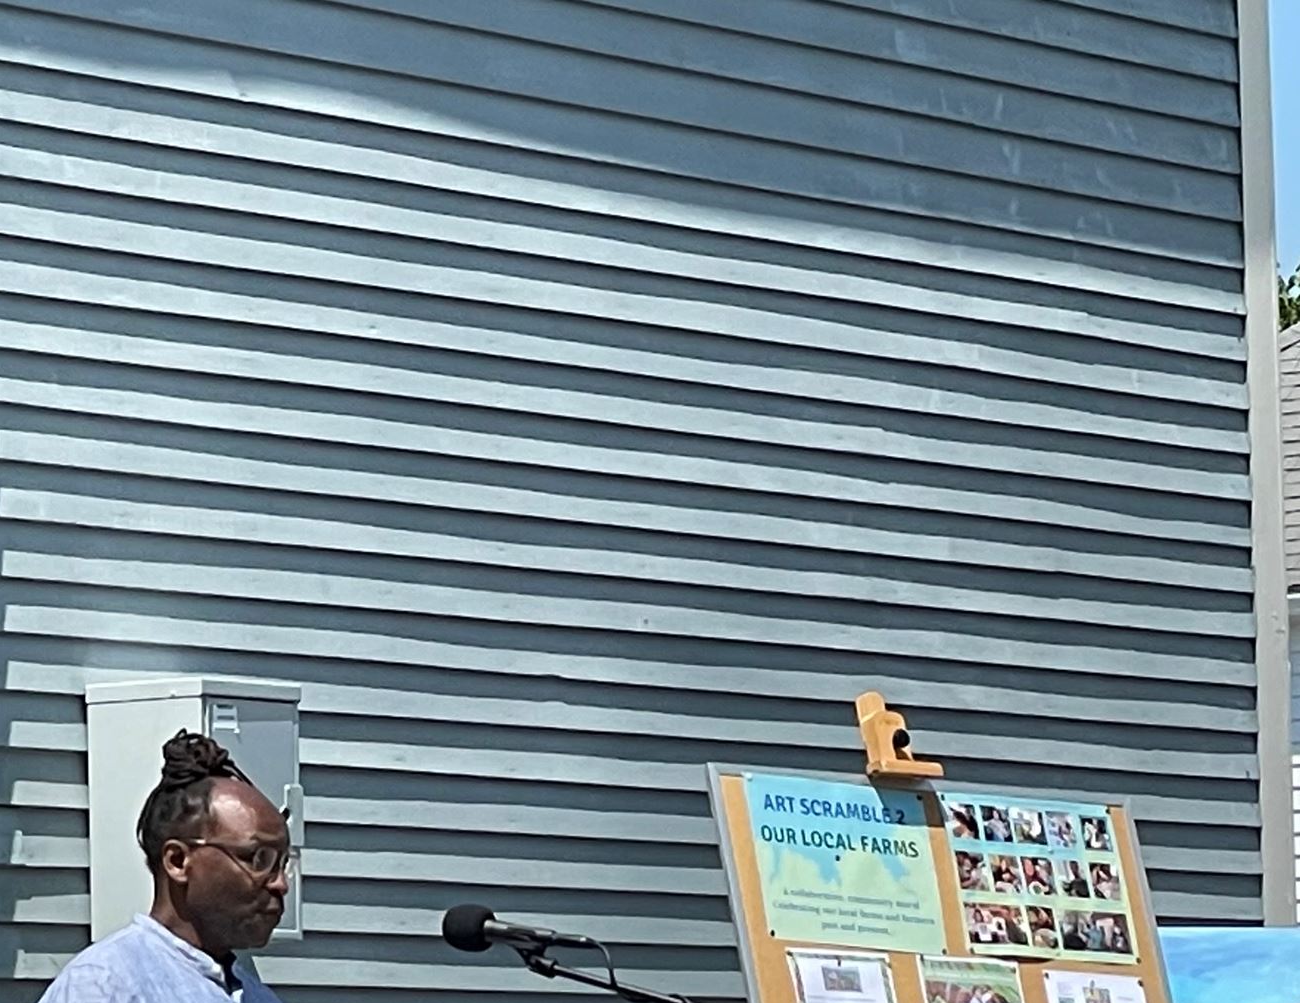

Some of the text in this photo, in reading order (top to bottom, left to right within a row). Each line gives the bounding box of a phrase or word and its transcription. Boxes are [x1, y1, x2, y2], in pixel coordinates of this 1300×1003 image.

[764, 793, 906, 826] ART SCRAMBLE 2
[760, 824, 920, 859] OUR LOCAL FARMS
